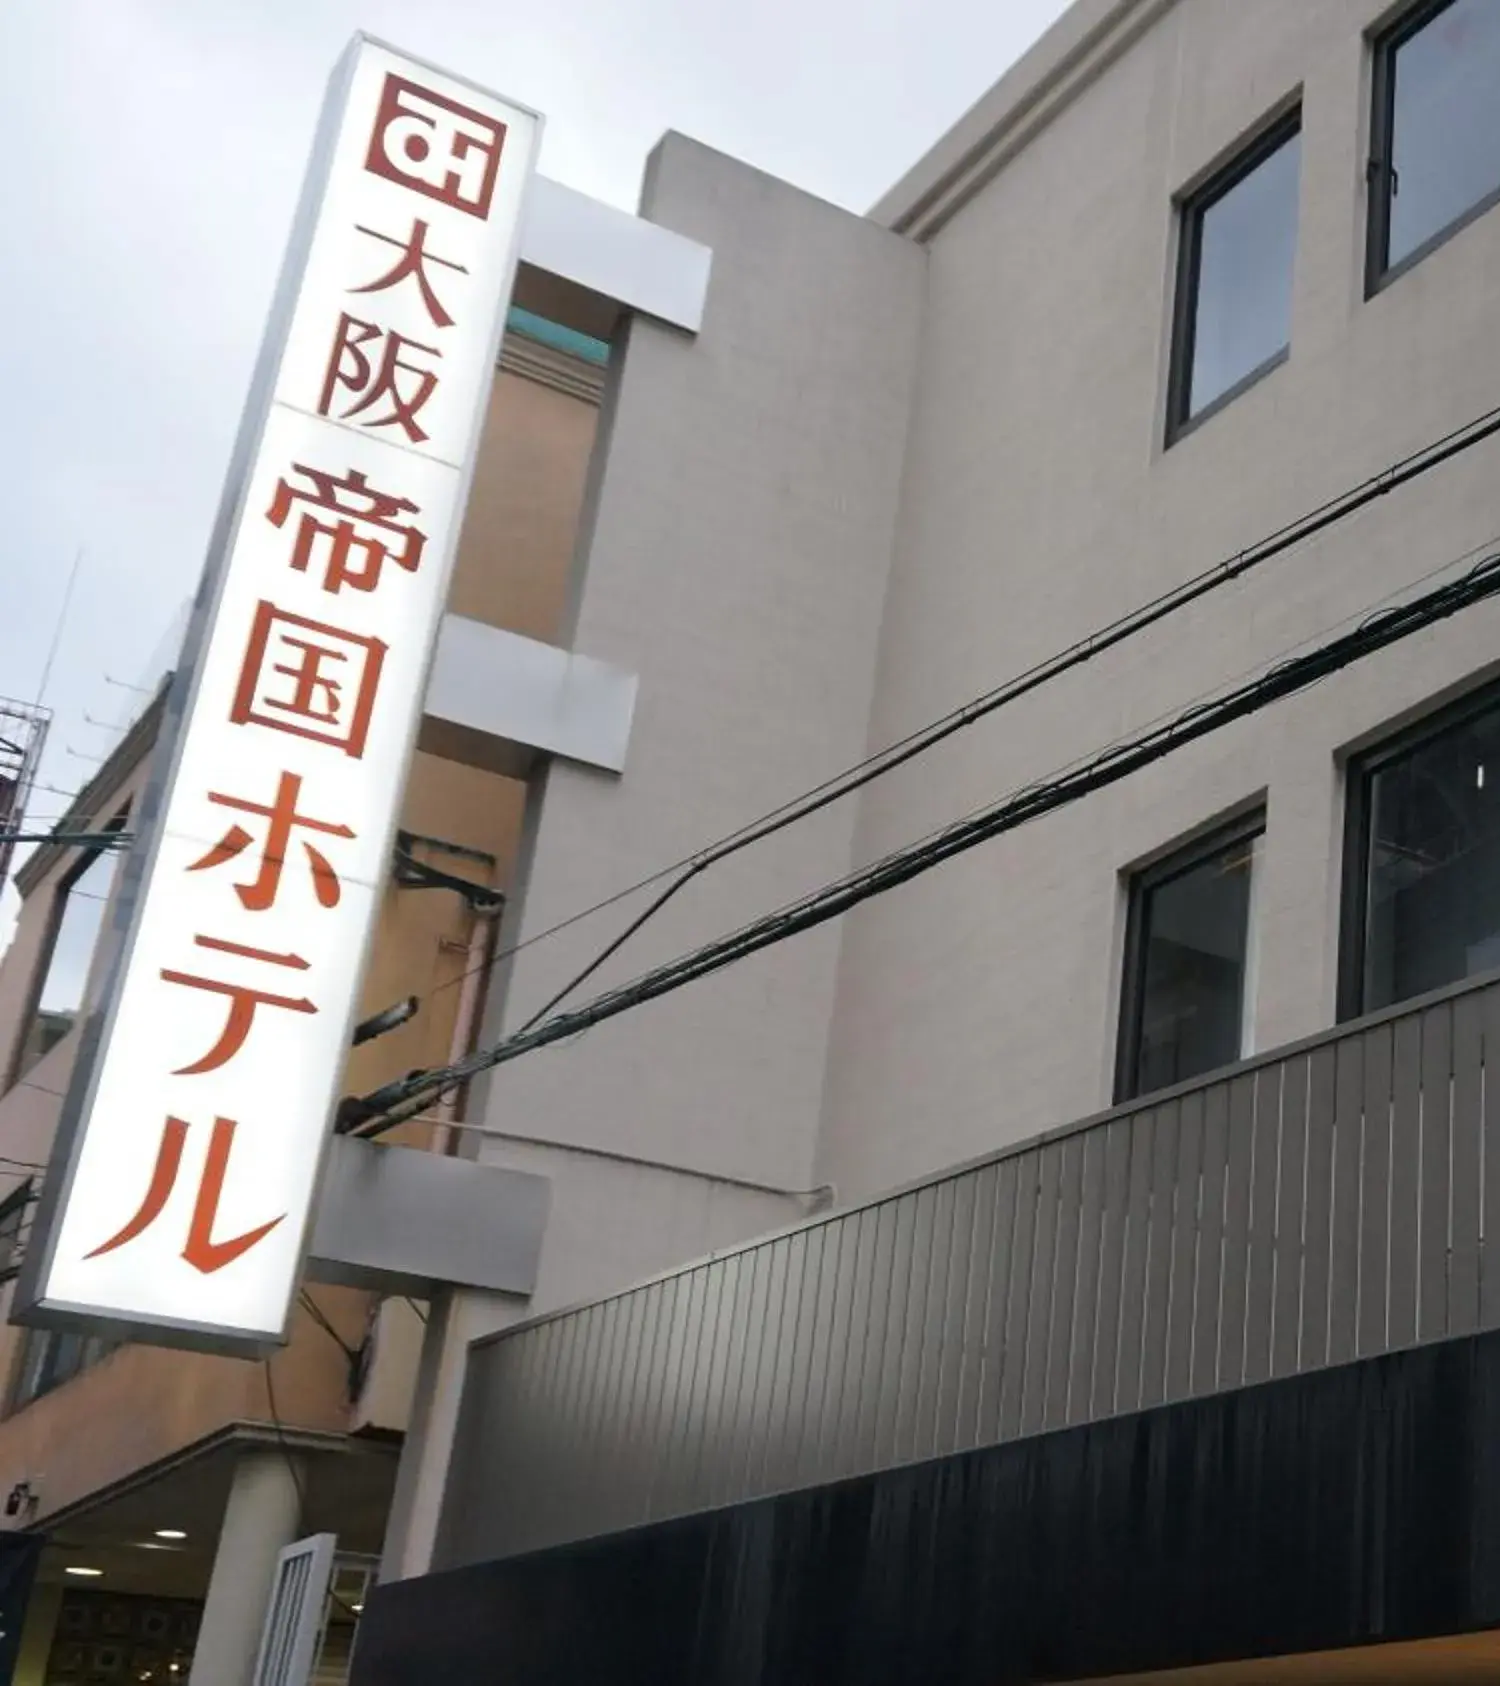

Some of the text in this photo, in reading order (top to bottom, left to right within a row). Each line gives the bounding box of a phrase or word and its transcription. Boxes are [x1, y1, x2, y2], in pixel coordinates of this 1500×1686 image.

[80, 216, 472, 1274] 大阪帝国ホテル
